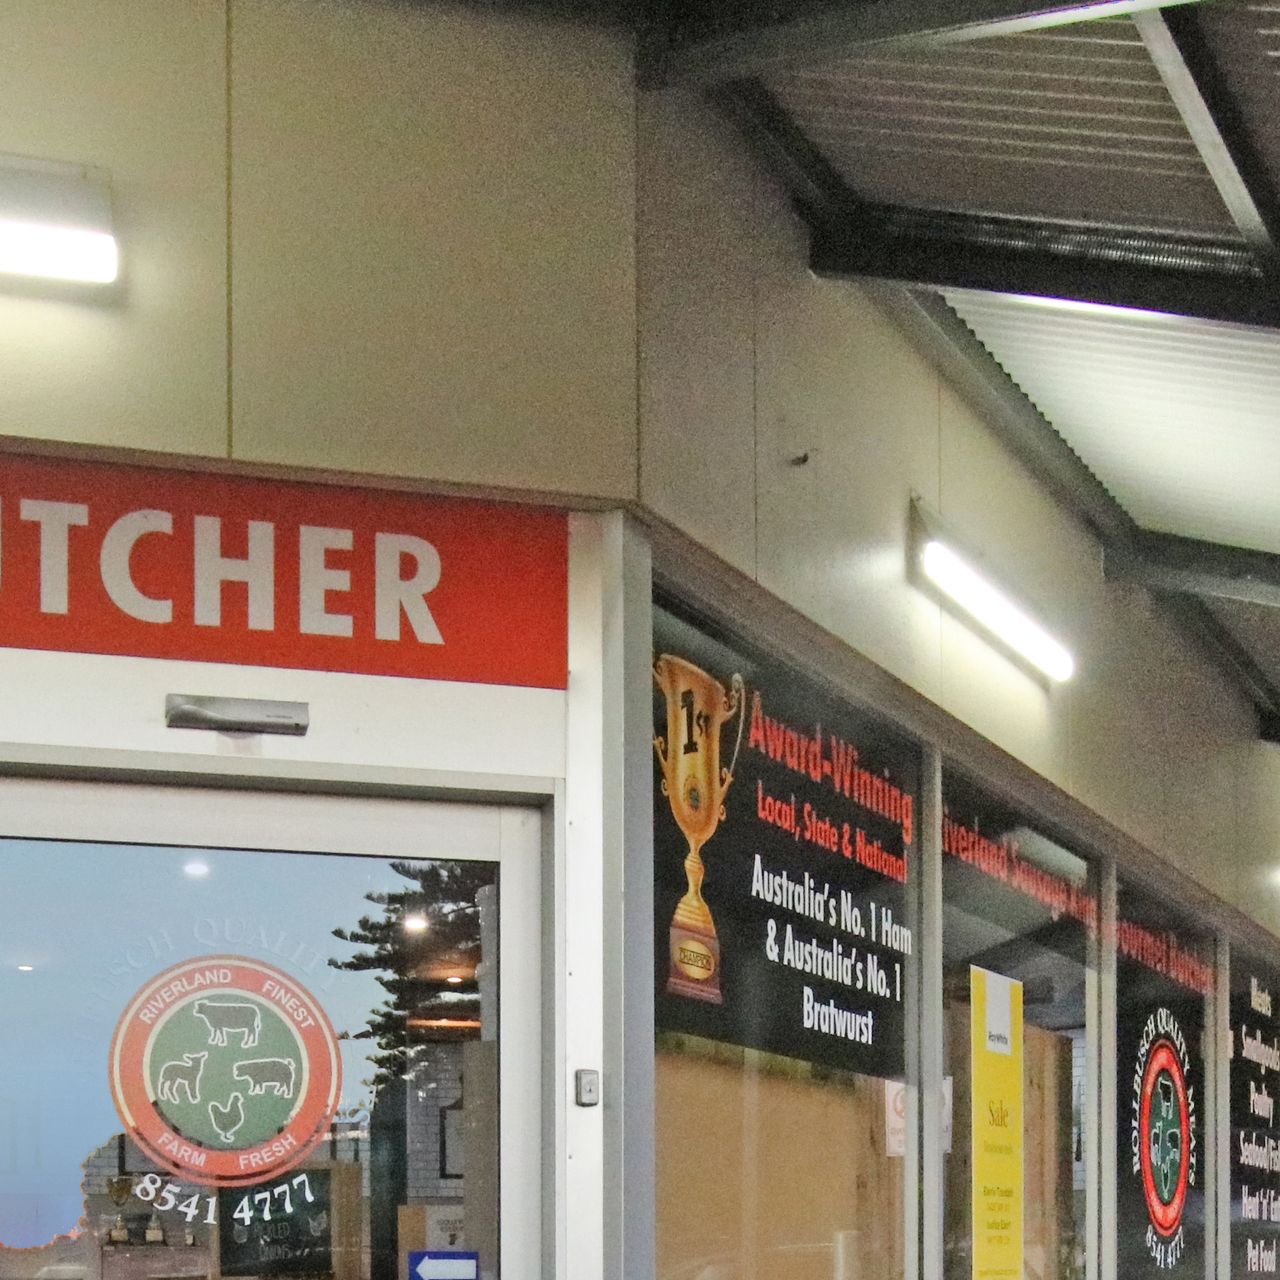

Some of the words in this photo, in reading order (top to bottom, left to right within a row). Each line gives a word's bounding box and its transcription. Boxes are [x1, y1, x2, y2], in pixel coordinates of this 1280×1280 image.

[748, 690, 913, 845] Award-Winning
[757, 778, 801, 842] Local,
[803, 802, 839, 853] State
[842, 821, 854, 859] &
[856, 826, 908, 885] National
[751, 853, 836, 927] Australia's
[840, 889, 866, 938] No.
[870, 901, 877, 942] 1
[881, 906, 912, 955] Ham
[678, 946, 712, 972] CHAMPION
[766, 918, 780, 963] &
[783, 923, 864, 990] Australia's
[867, 952, 891, 998] No.
[894, 962, 902, 1002] 1
[138, 968, 233, 1025] RIVERLAND
[262, 980, 316, 1030] FINEST
[803, 985, 874, 1045] Bratwurst
[1250, 975, 1272, 1018] Meats
[1241, 1023, 1280, 1075] Smallgoods
[988, 1099, 1009, 1129] Sale
[1249, 1080, 1274, 1128] Poultry
[157, 1132, 207, 1167] FARM
[239, 1132, 298, 1171] FRESH
[134, 1172, 218, 1226] 8541
[232, 1172, 316, 1227] 4777
[1241, 1184, 1259, 1220] Heat
[1247, 1237, 1260, 1272] Pet
[1260, 1238, 1276, 1272] Food
